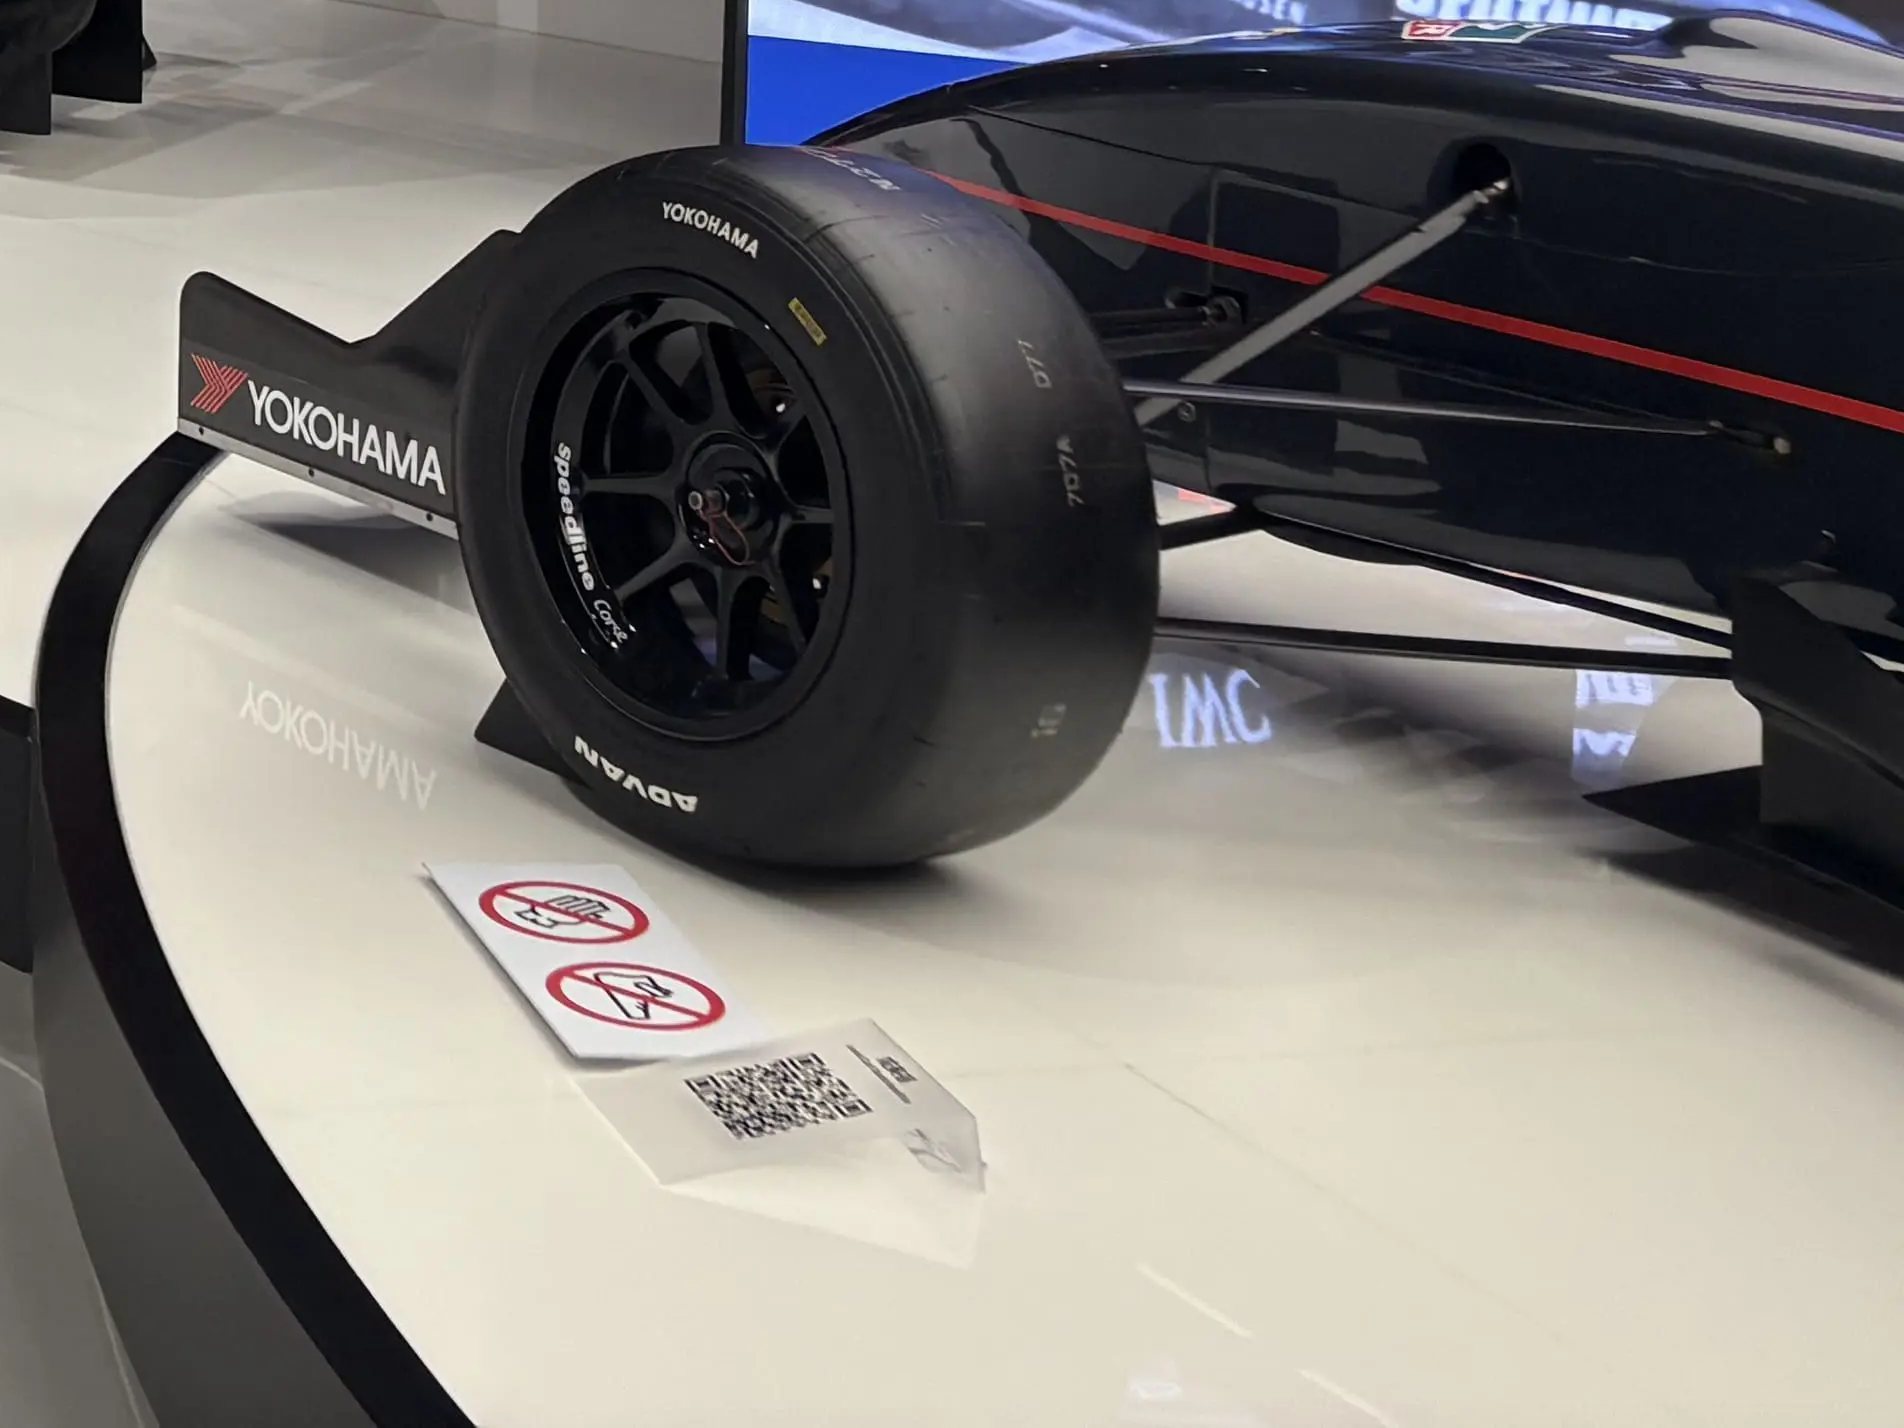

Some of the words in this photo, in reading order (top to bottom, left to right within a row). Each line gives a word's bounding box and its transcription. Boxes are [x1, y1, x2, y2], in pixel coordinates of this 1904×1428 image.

[661, 200, 761, 258] YOKOHAMA
[246, 379, 447, 497] YOKOHAMA
[554, 439, 596, 593] speedline
[592, 598, 632, 645] Corse
[574, 735, 700, 815] ADVAN
